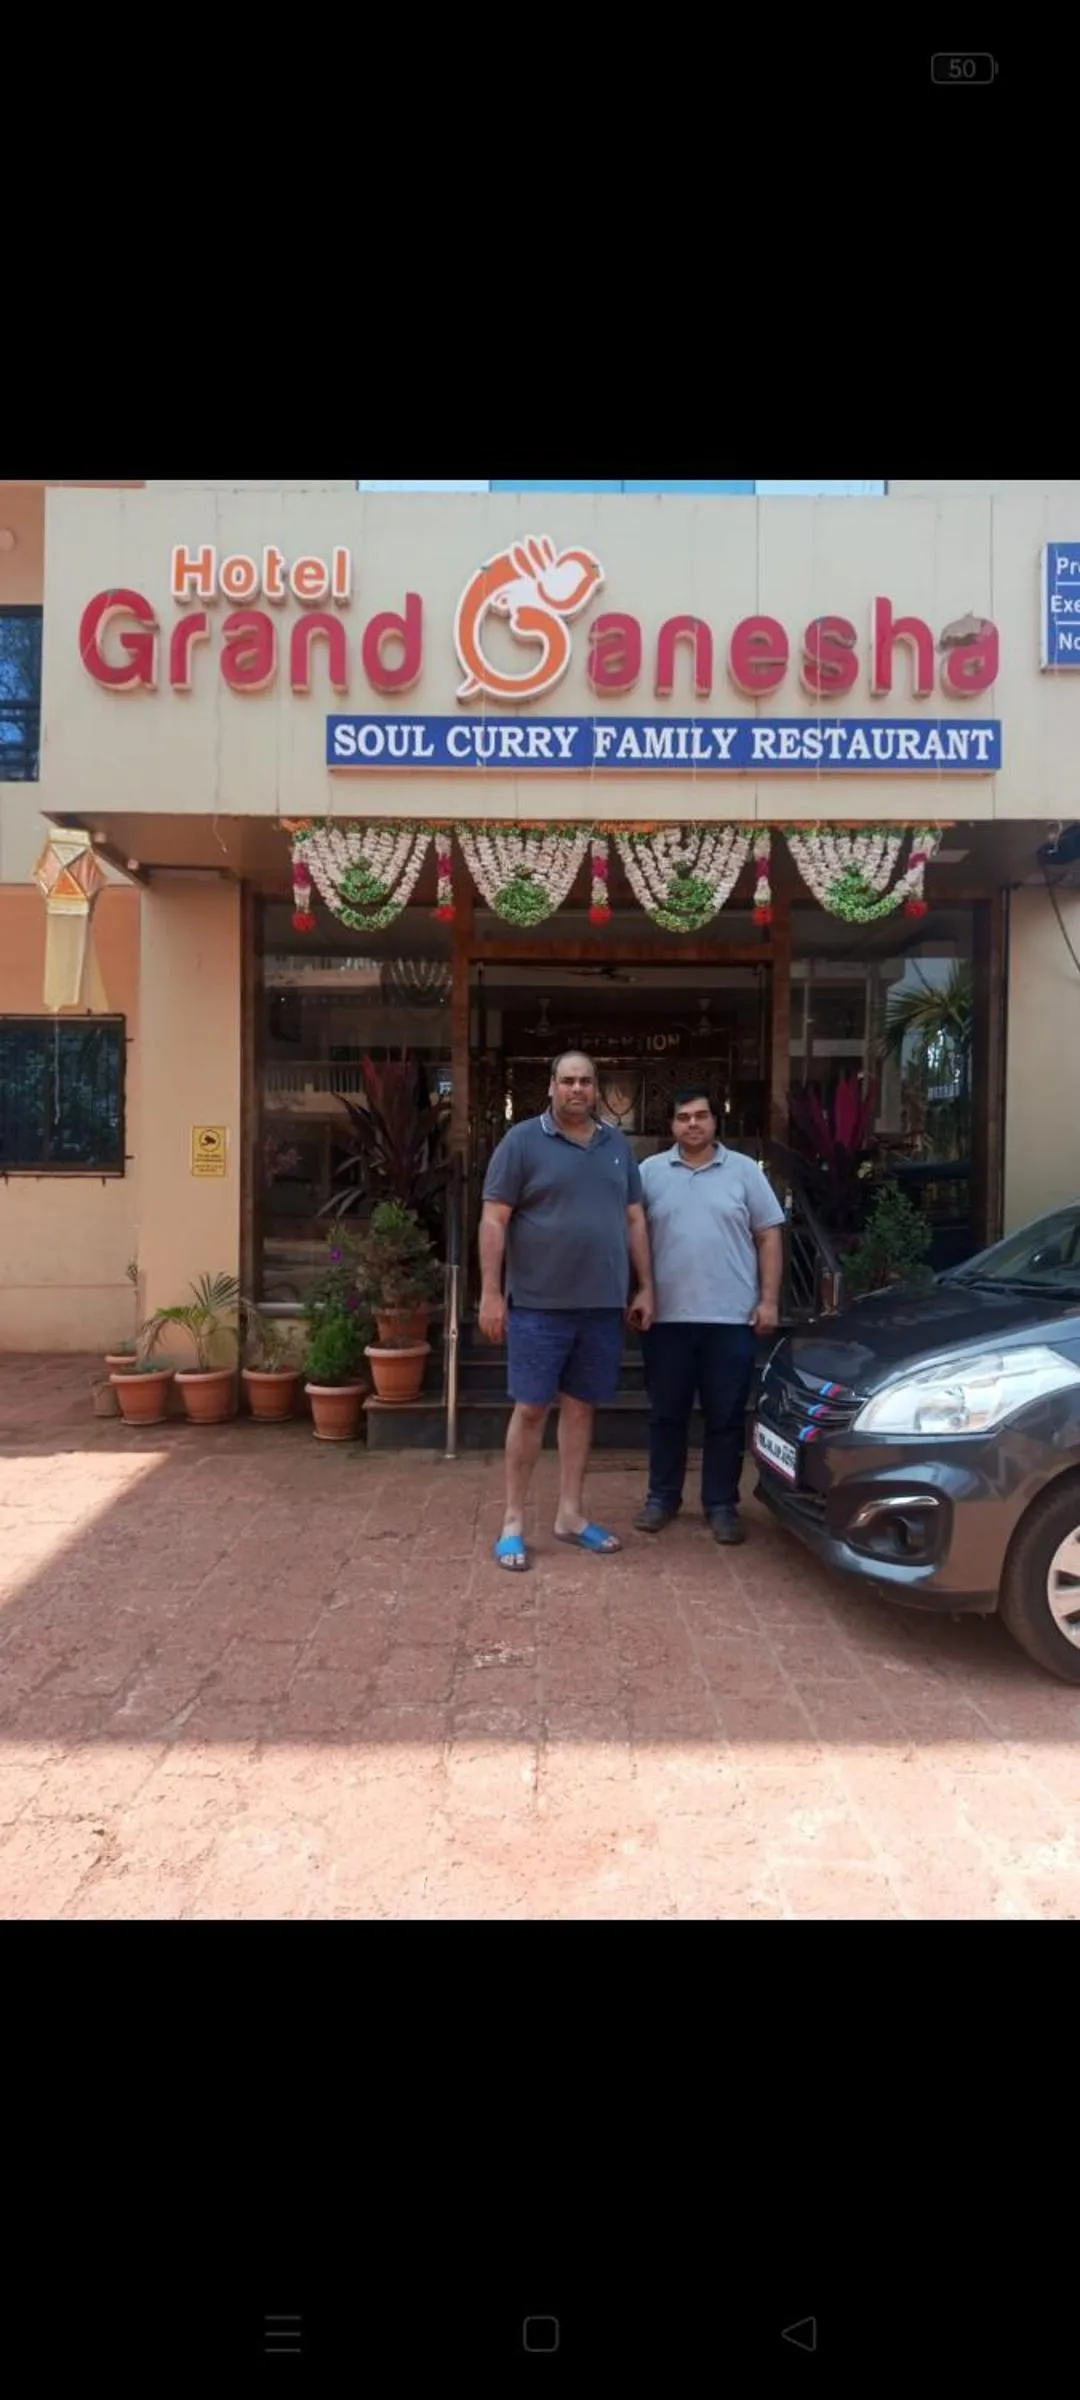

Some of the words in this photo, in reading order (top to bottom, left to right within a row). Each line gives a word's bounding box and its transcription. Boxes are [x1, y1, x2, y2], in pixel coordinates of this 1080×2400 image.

[171, 545, 351, 604] Hotel
[79, 588, 423, 692] Grand
[454, 535, 1000, 704] Ganesha
[334, 724, 435, 757] SOUL
[446, 726, 579, 758] CURRY
[593, 727, 738, 760] FAMILY
[751, 728, 994, 760] RESTAURANT
